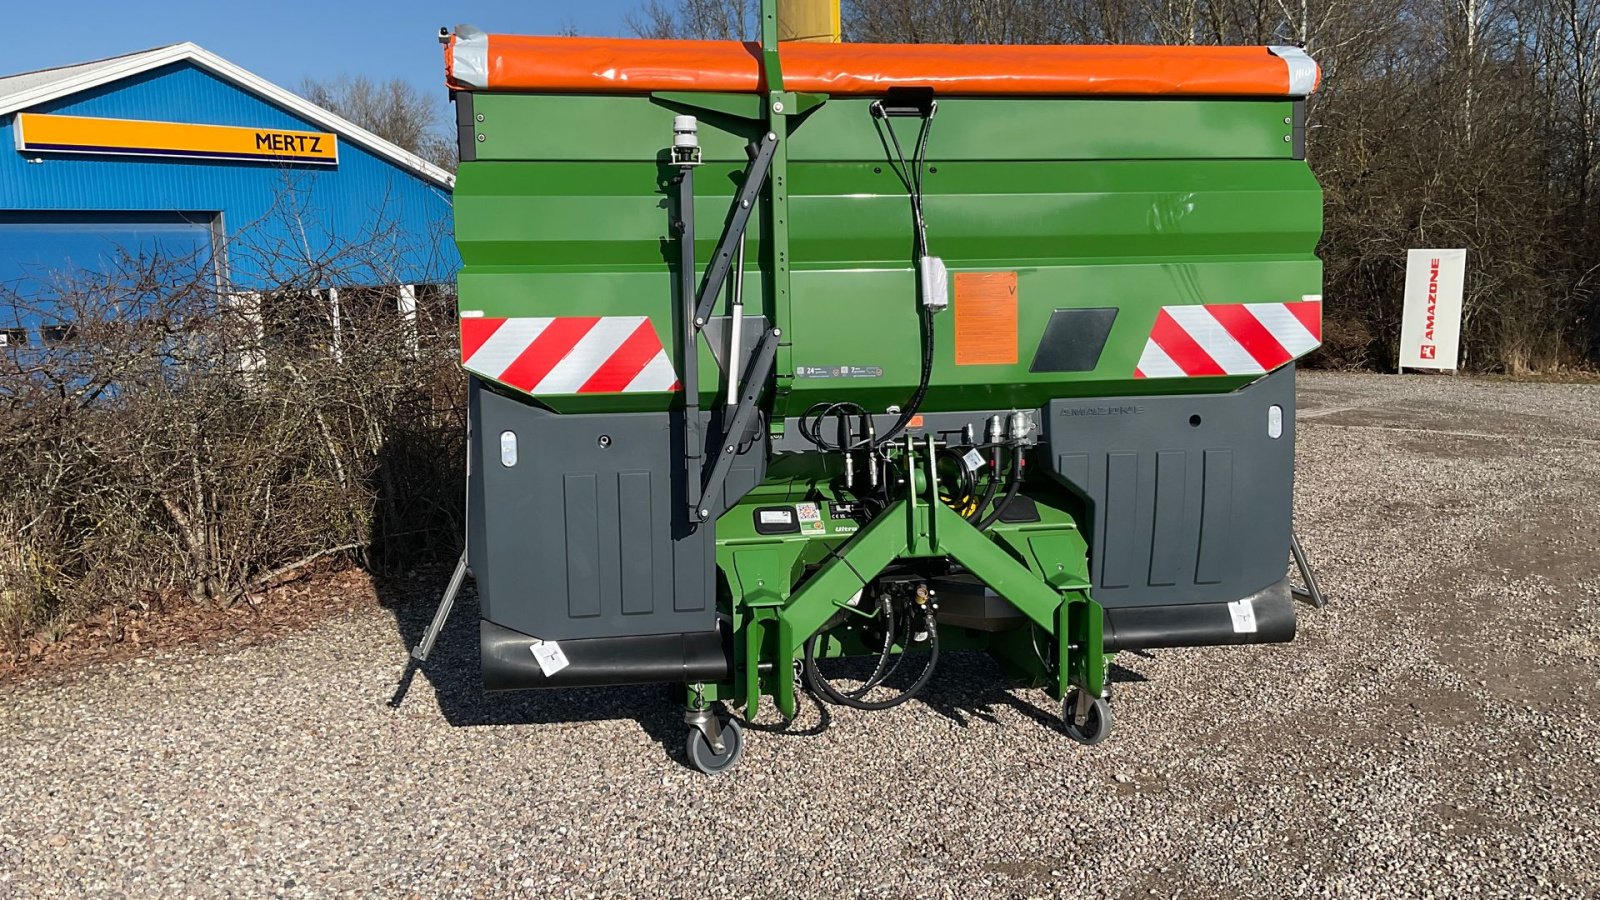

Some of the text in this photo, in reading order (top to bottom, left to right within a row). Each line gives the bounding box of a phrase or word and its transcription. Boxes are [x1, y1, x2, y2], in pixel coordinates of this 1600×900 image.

[255, 133, 323, 153] MERTZ
[1425, 258, 1440, 341] AMAZONE
[1060, 406, 1145, 416] AMAZONE
